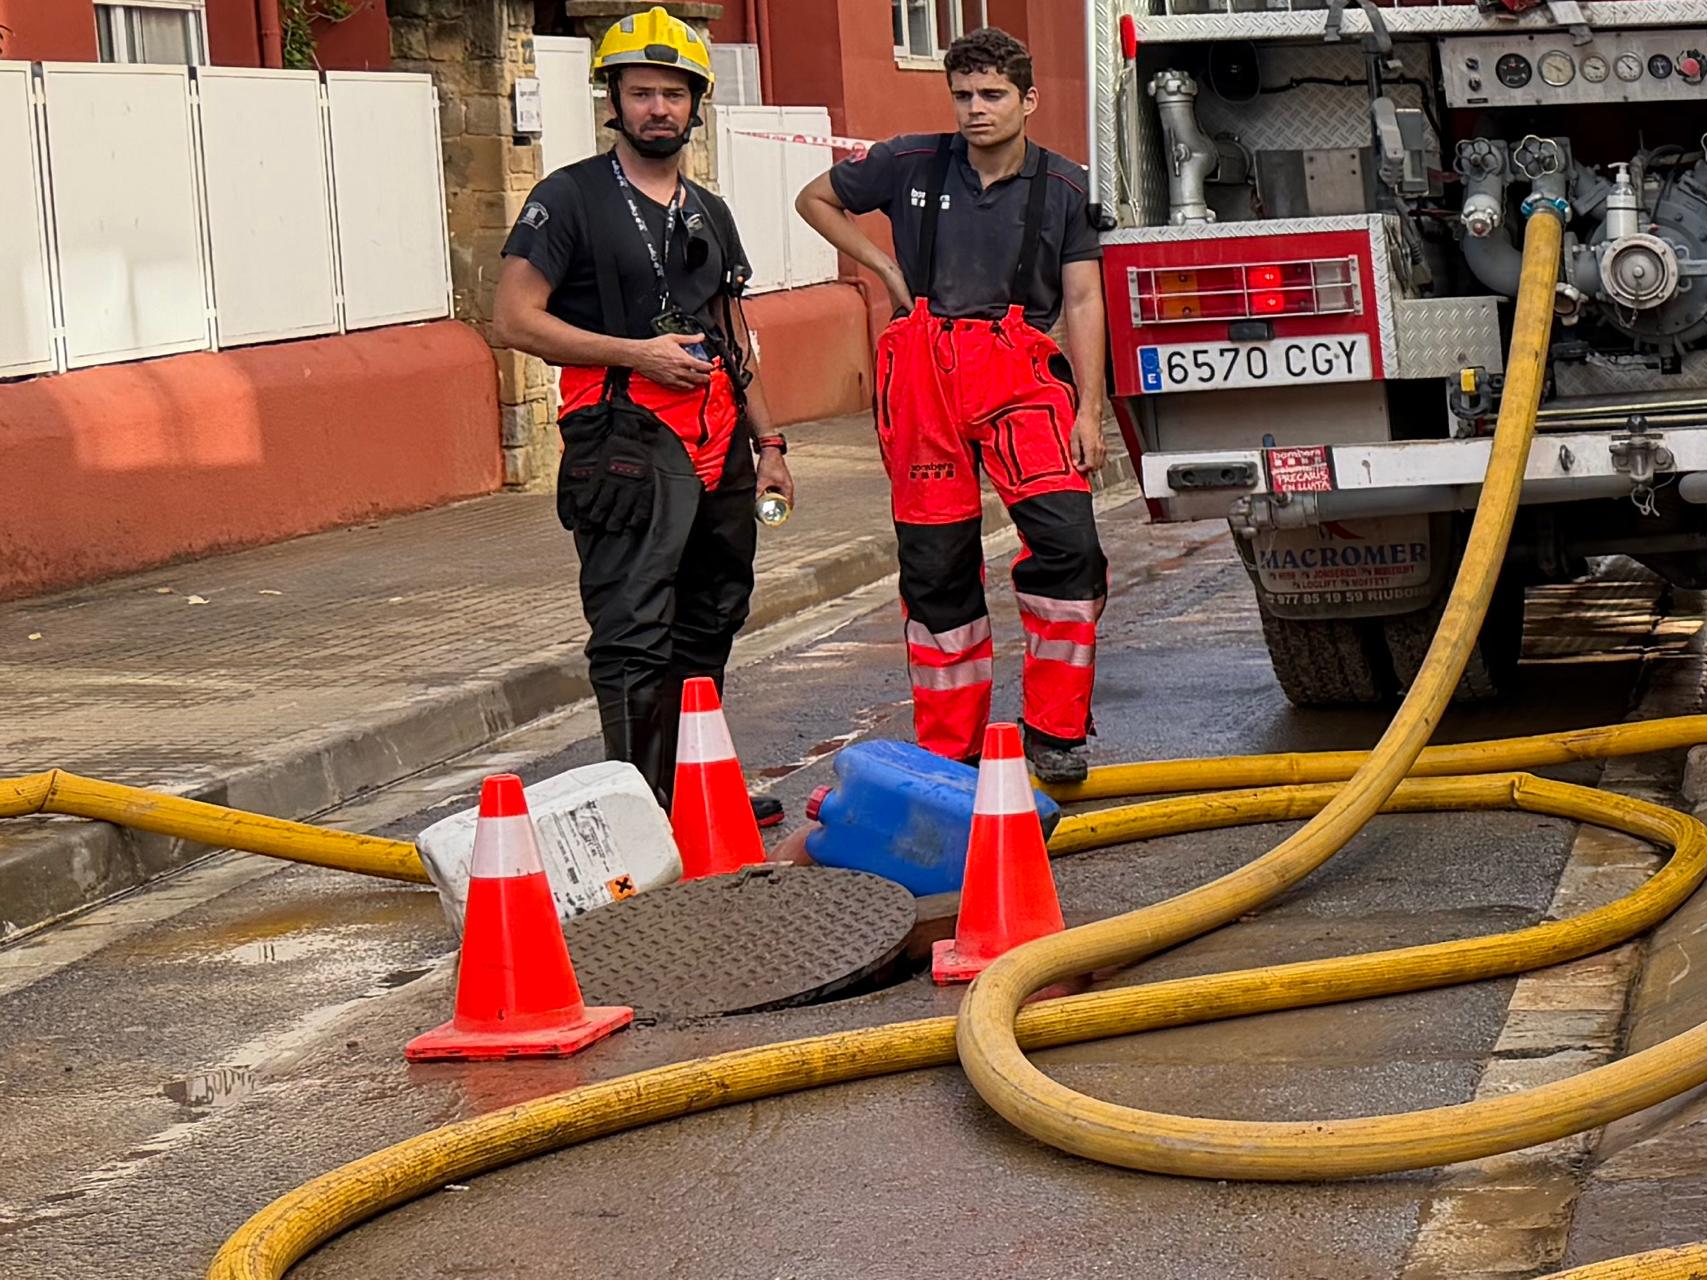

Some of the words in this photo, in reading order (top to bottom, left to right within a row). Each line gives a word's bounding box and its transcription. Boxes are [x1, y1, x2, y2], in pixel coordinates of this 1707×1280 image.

[1147, 373, 1158, 384] E
[1166, 345, 1269, 385] 6570
[1284, 340, 1358, 378] CGY
[1277, 471, 1329, 486] PRECARIS
[1260, 543, 1428, 570] MACROMER
[1278, 593, 1300, 605] 977
